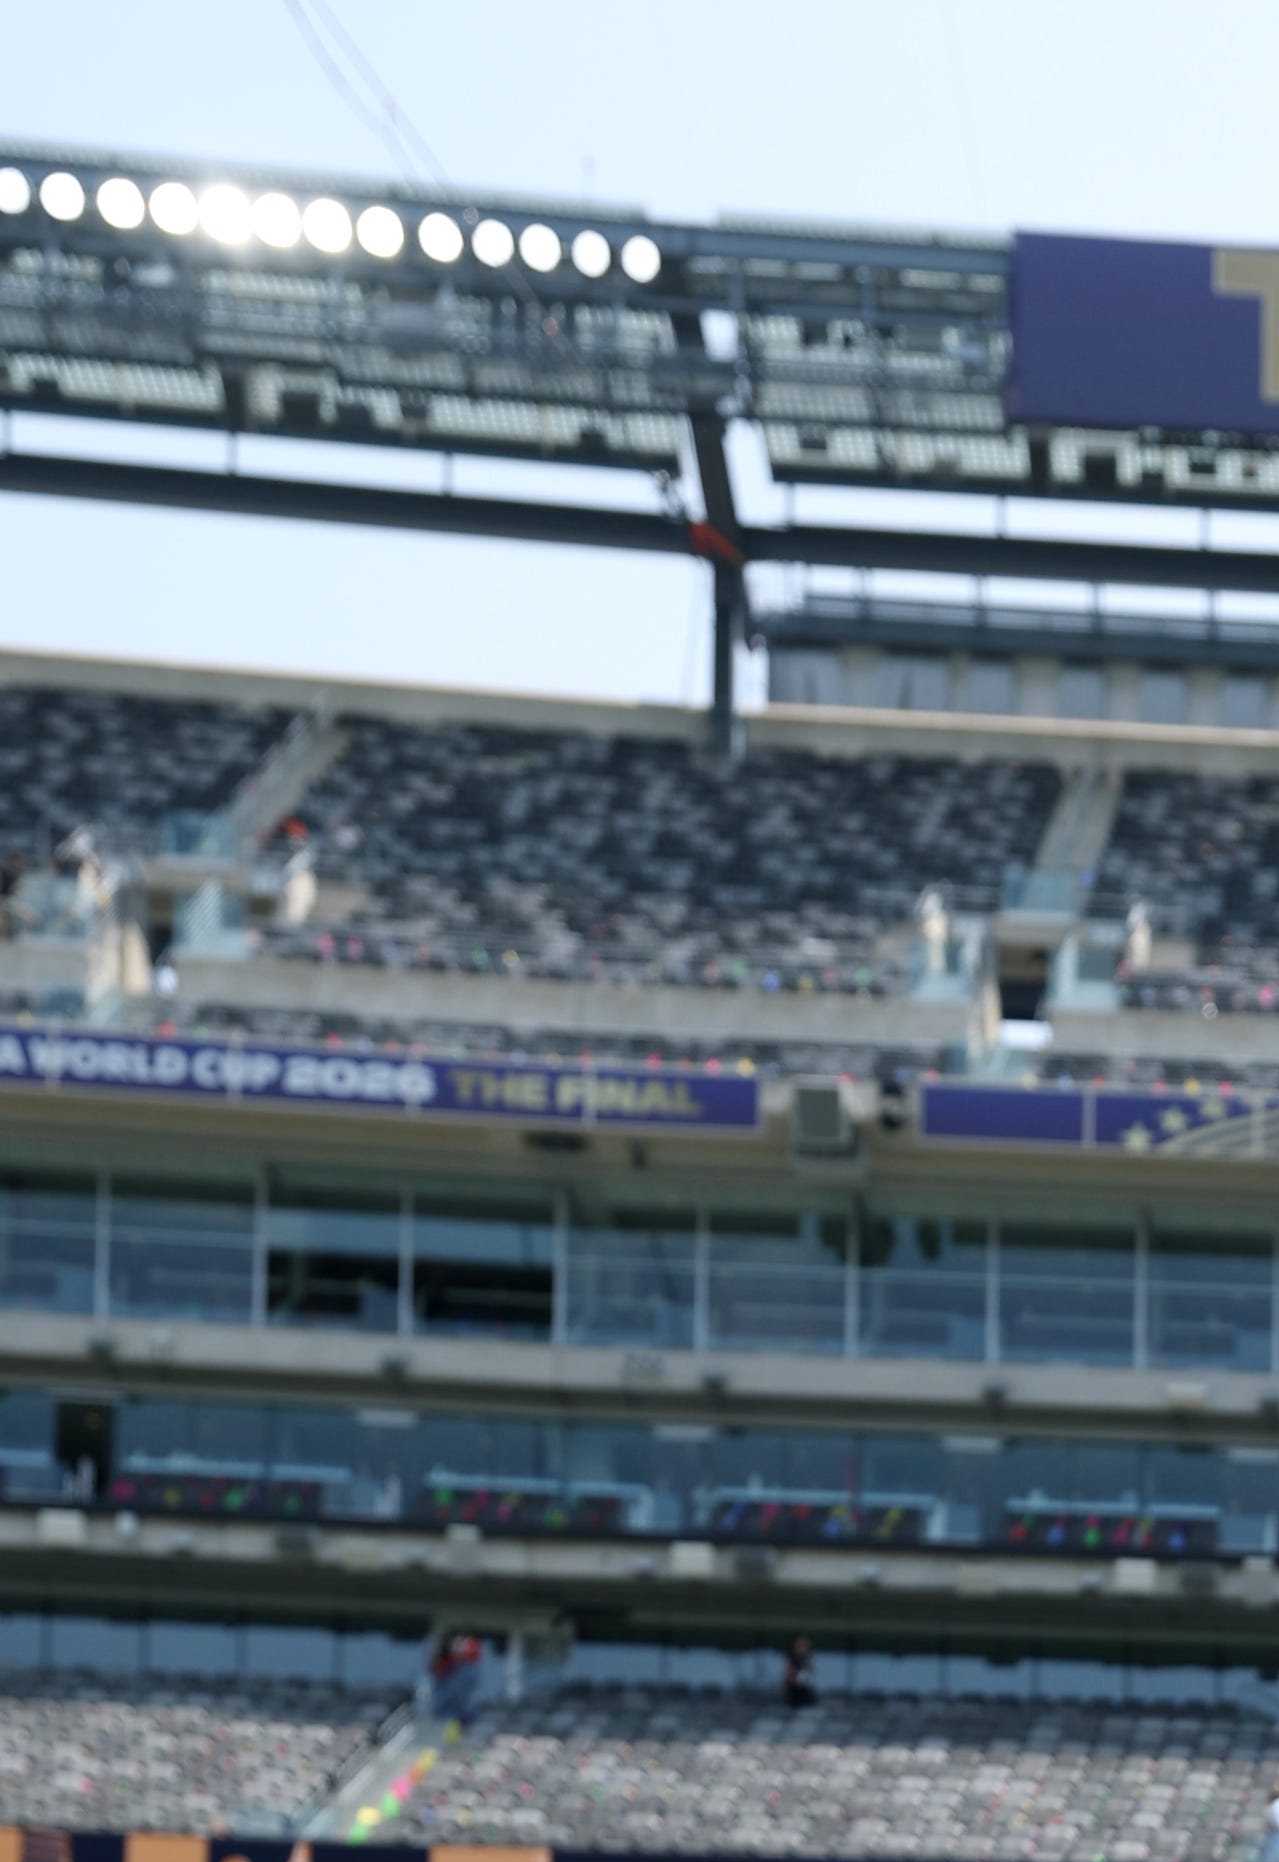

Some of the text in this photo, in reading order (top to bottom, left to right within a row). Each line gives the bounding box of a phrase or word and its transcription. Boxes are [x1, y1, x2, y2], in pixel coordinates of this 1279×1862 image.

[29, 1035, 188, 1085] WORLD
[192, 1048, 281, 1090] CUP
[282, 1054, 436, 1100] 2026
[453, 1069, 548, 1107] THE
